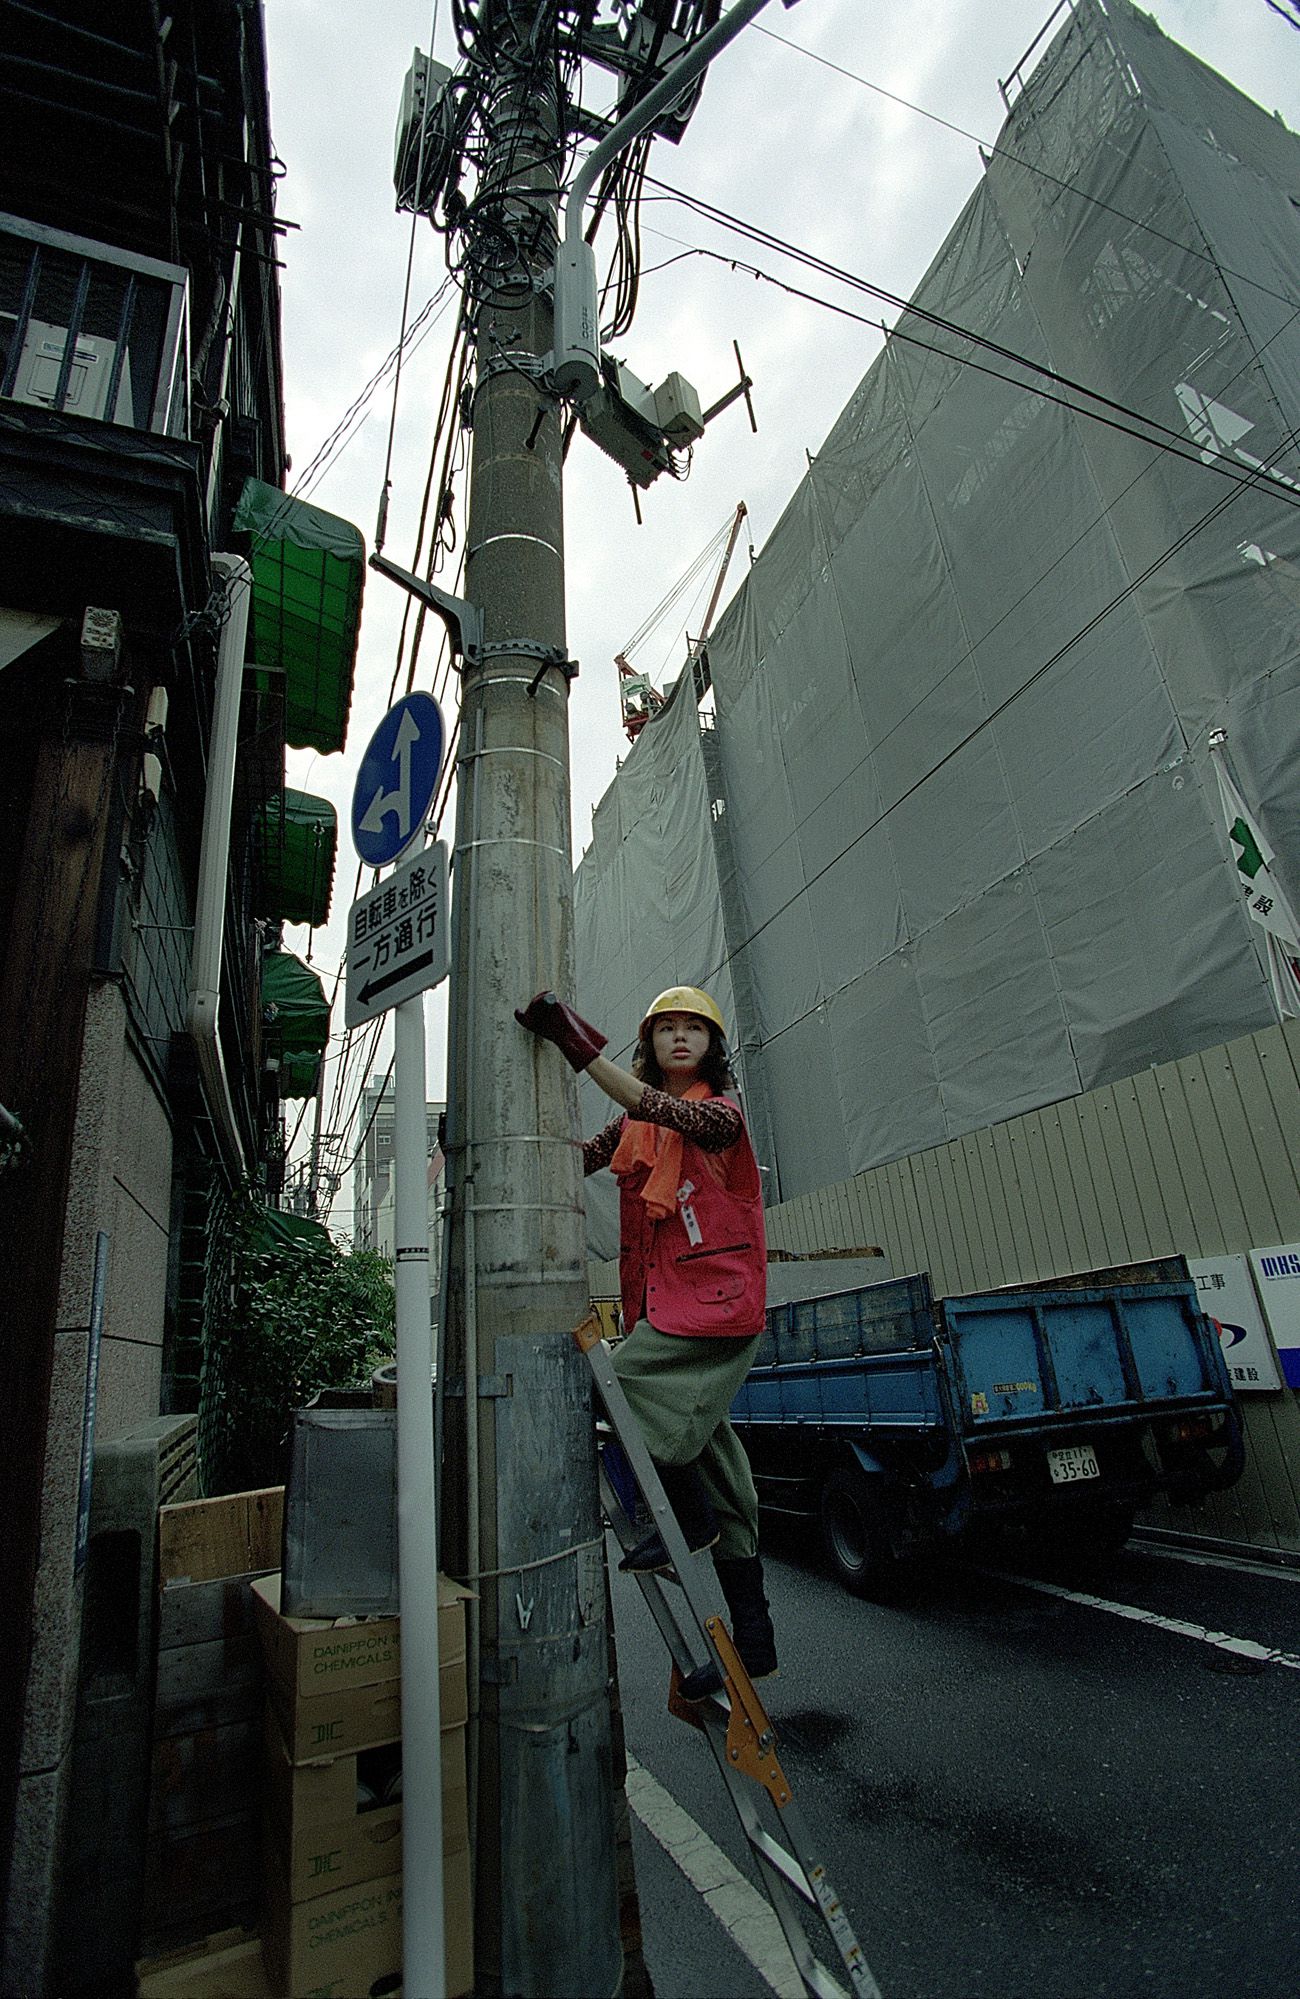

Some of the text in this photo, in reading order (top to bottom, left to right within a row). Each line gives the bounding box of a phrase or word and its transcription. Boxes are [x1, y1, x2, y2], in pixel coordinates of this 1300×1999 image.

[354, 865, 437, 941] 自転車を除く
[352, 902, 437, 971] 一方通行
[1192, 1273, 1227, 1290] 工事
[313, 1635, 387, 1660] DAINIPPON
